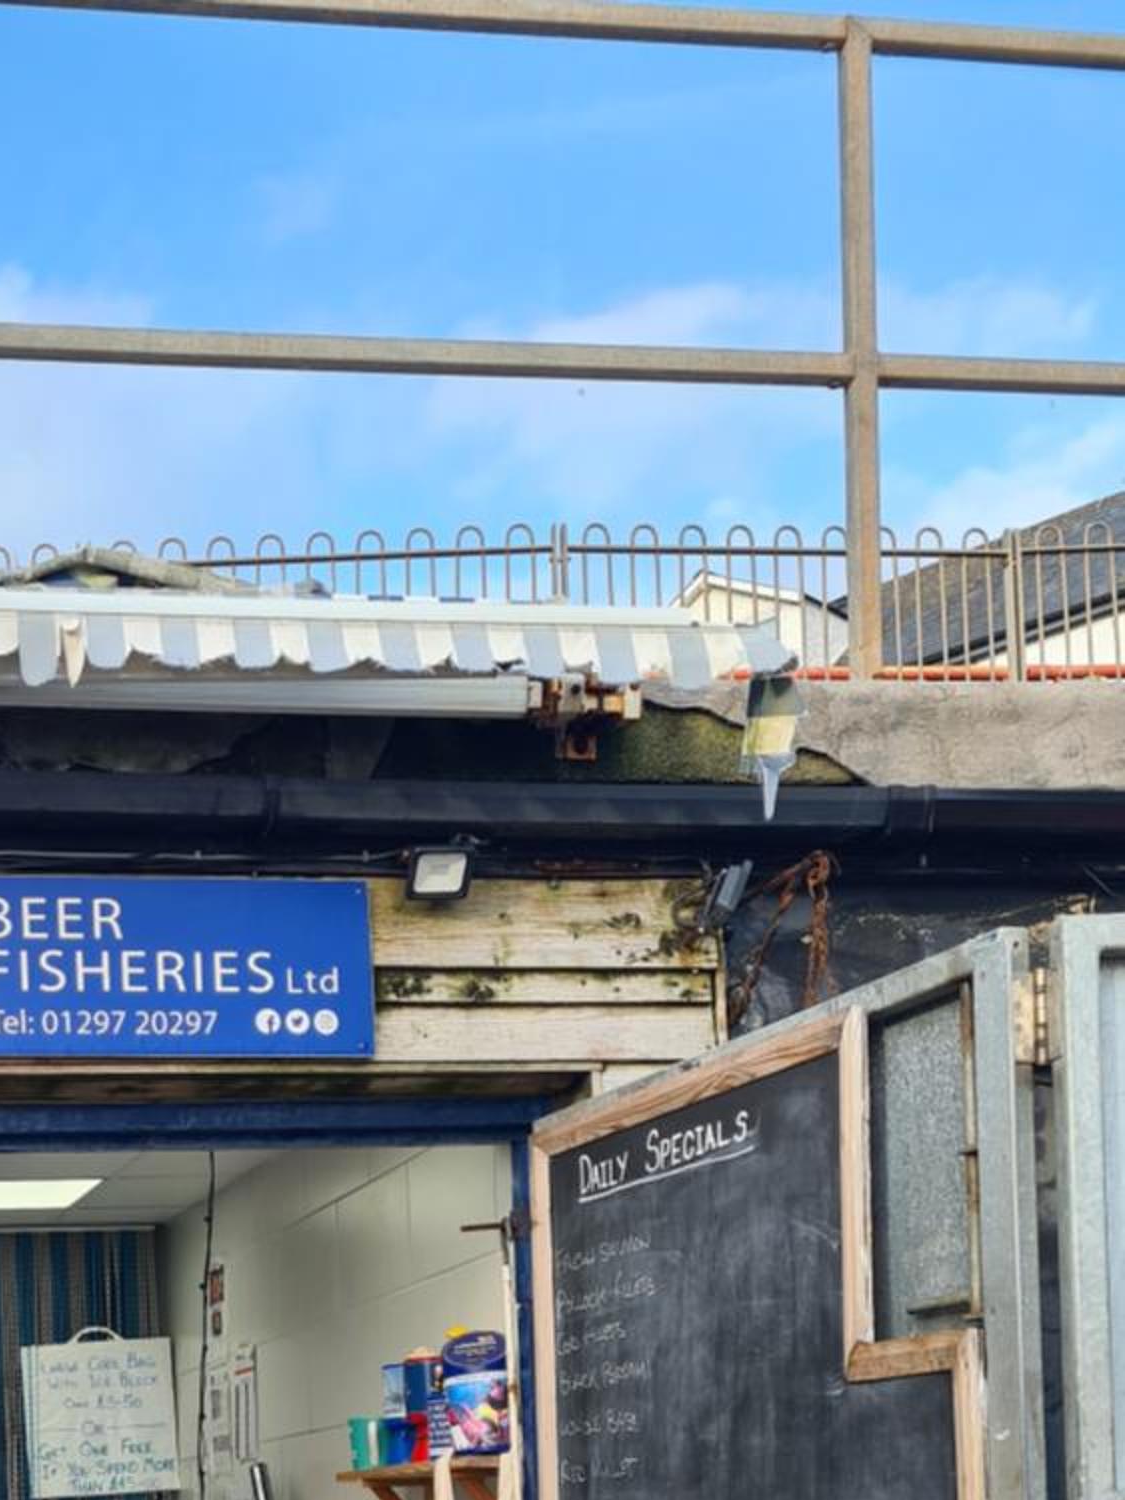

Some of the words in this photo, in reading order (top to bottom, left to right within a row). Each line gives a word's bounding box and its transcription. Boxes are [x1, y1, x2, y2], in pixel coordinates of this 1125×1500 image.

[287, 967, 339, 994] Ltd
[42, 1010, 125, 1035] 01297
[135, 1011, 218, 1035] 20297
